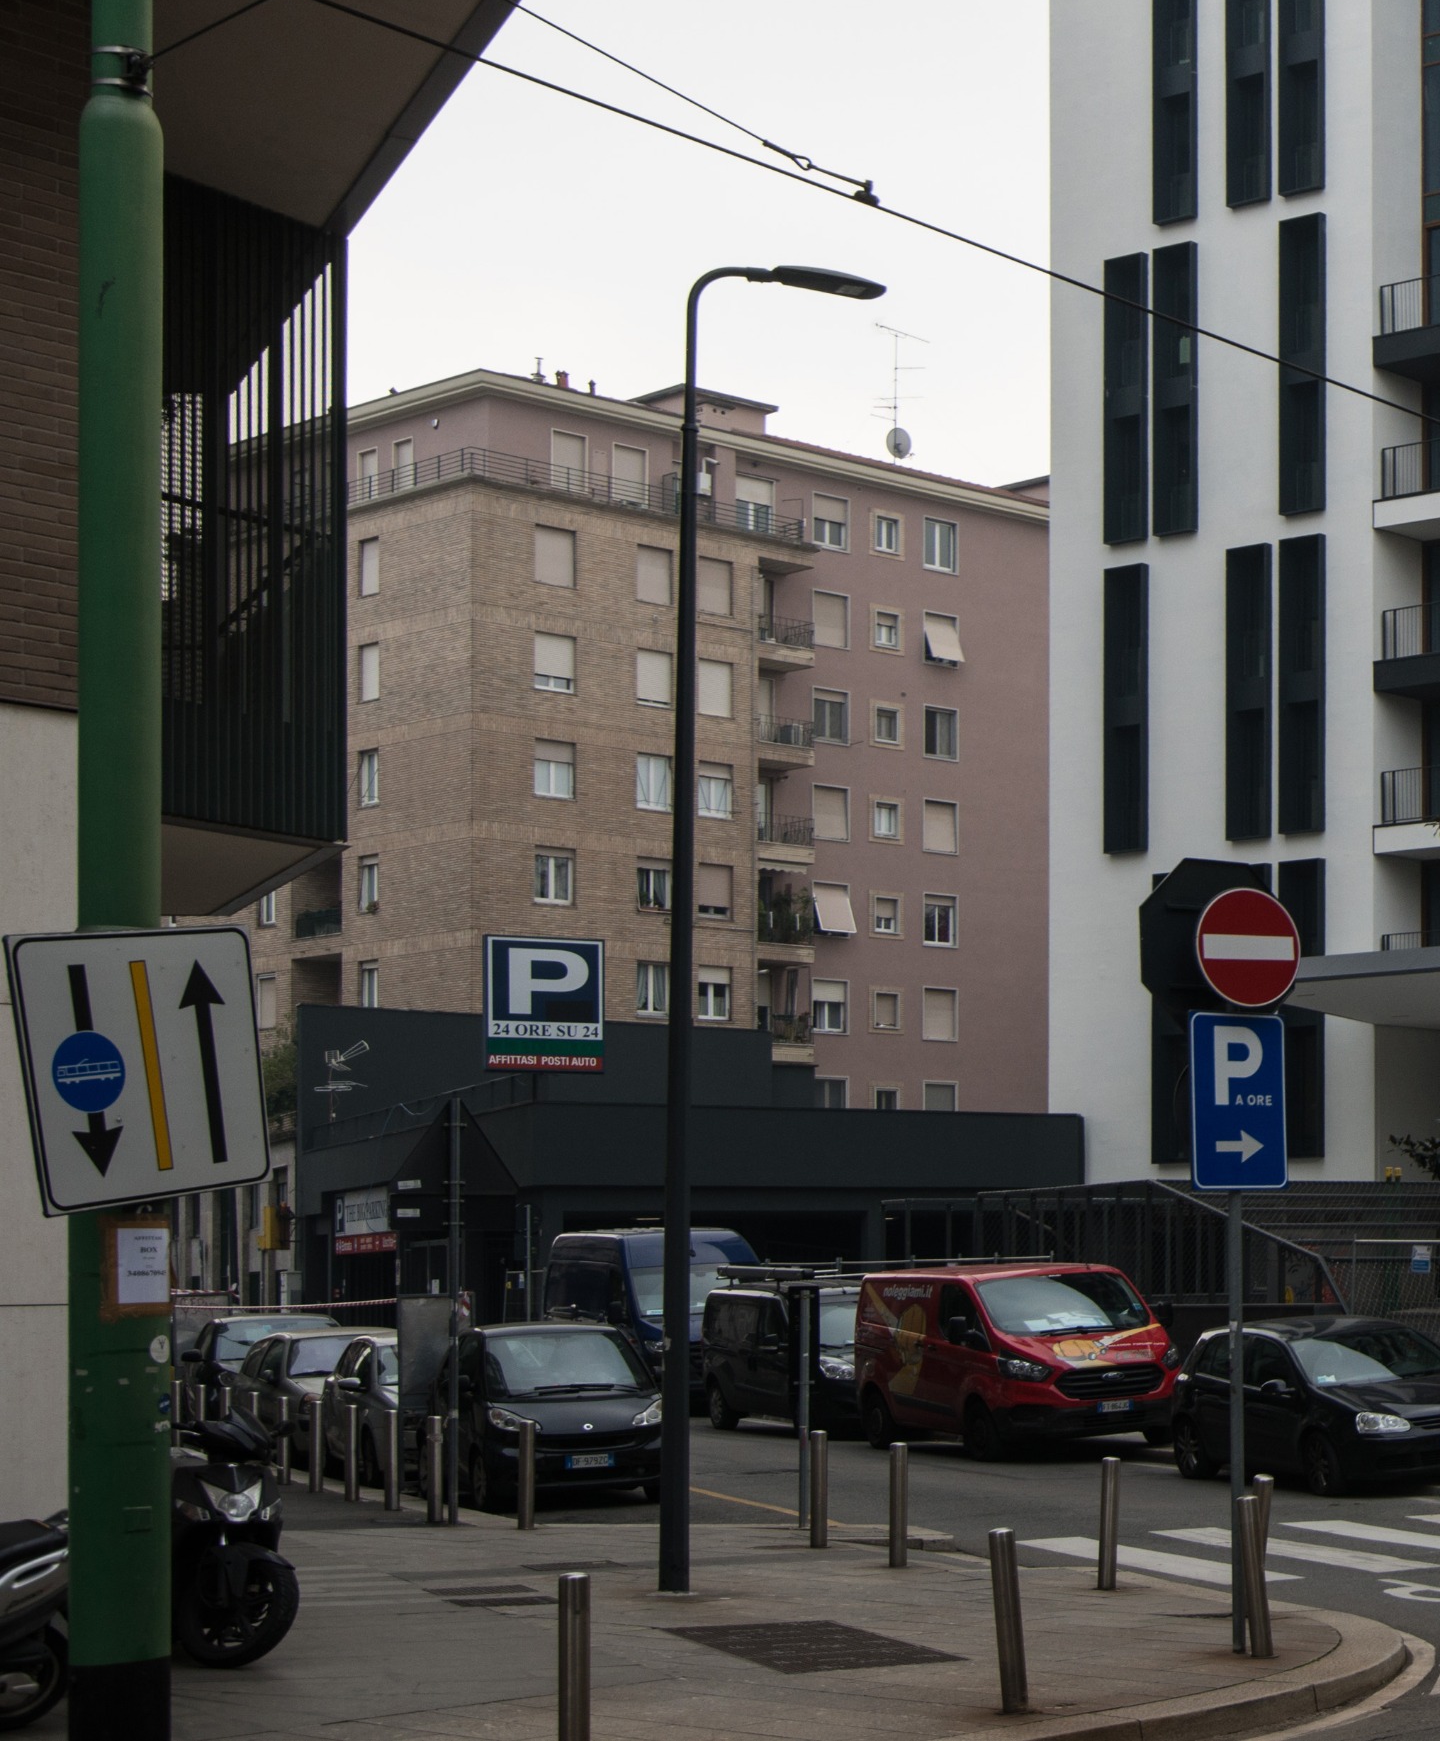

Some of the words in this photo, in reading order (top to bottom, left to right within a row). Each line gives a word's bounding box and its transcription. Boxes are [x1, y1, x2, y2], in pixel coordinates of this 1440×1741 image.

[508, 947, 589, 1015] P
[493, 1023, 510, 1035] 24
[515, 1024, 551, 1036] ORE
[556, 1025, 578, 1037] SU
[582, 1025, 599, 1038] 24
[488, 1054, 537, 1065] AFFITTASI
[541, 1055, 569, 1066] POSTI
[571, 1057, 597, 1067] AUTO
[1213, 1025, 1264, 1106] P
[1235, 1094, 1244, 1106] A
[1246, 1094, 1273, 1107] ORE
[140, 1246, 158, 1254] BOX
[882, 1284, 934, 1300] noleggiami.it
